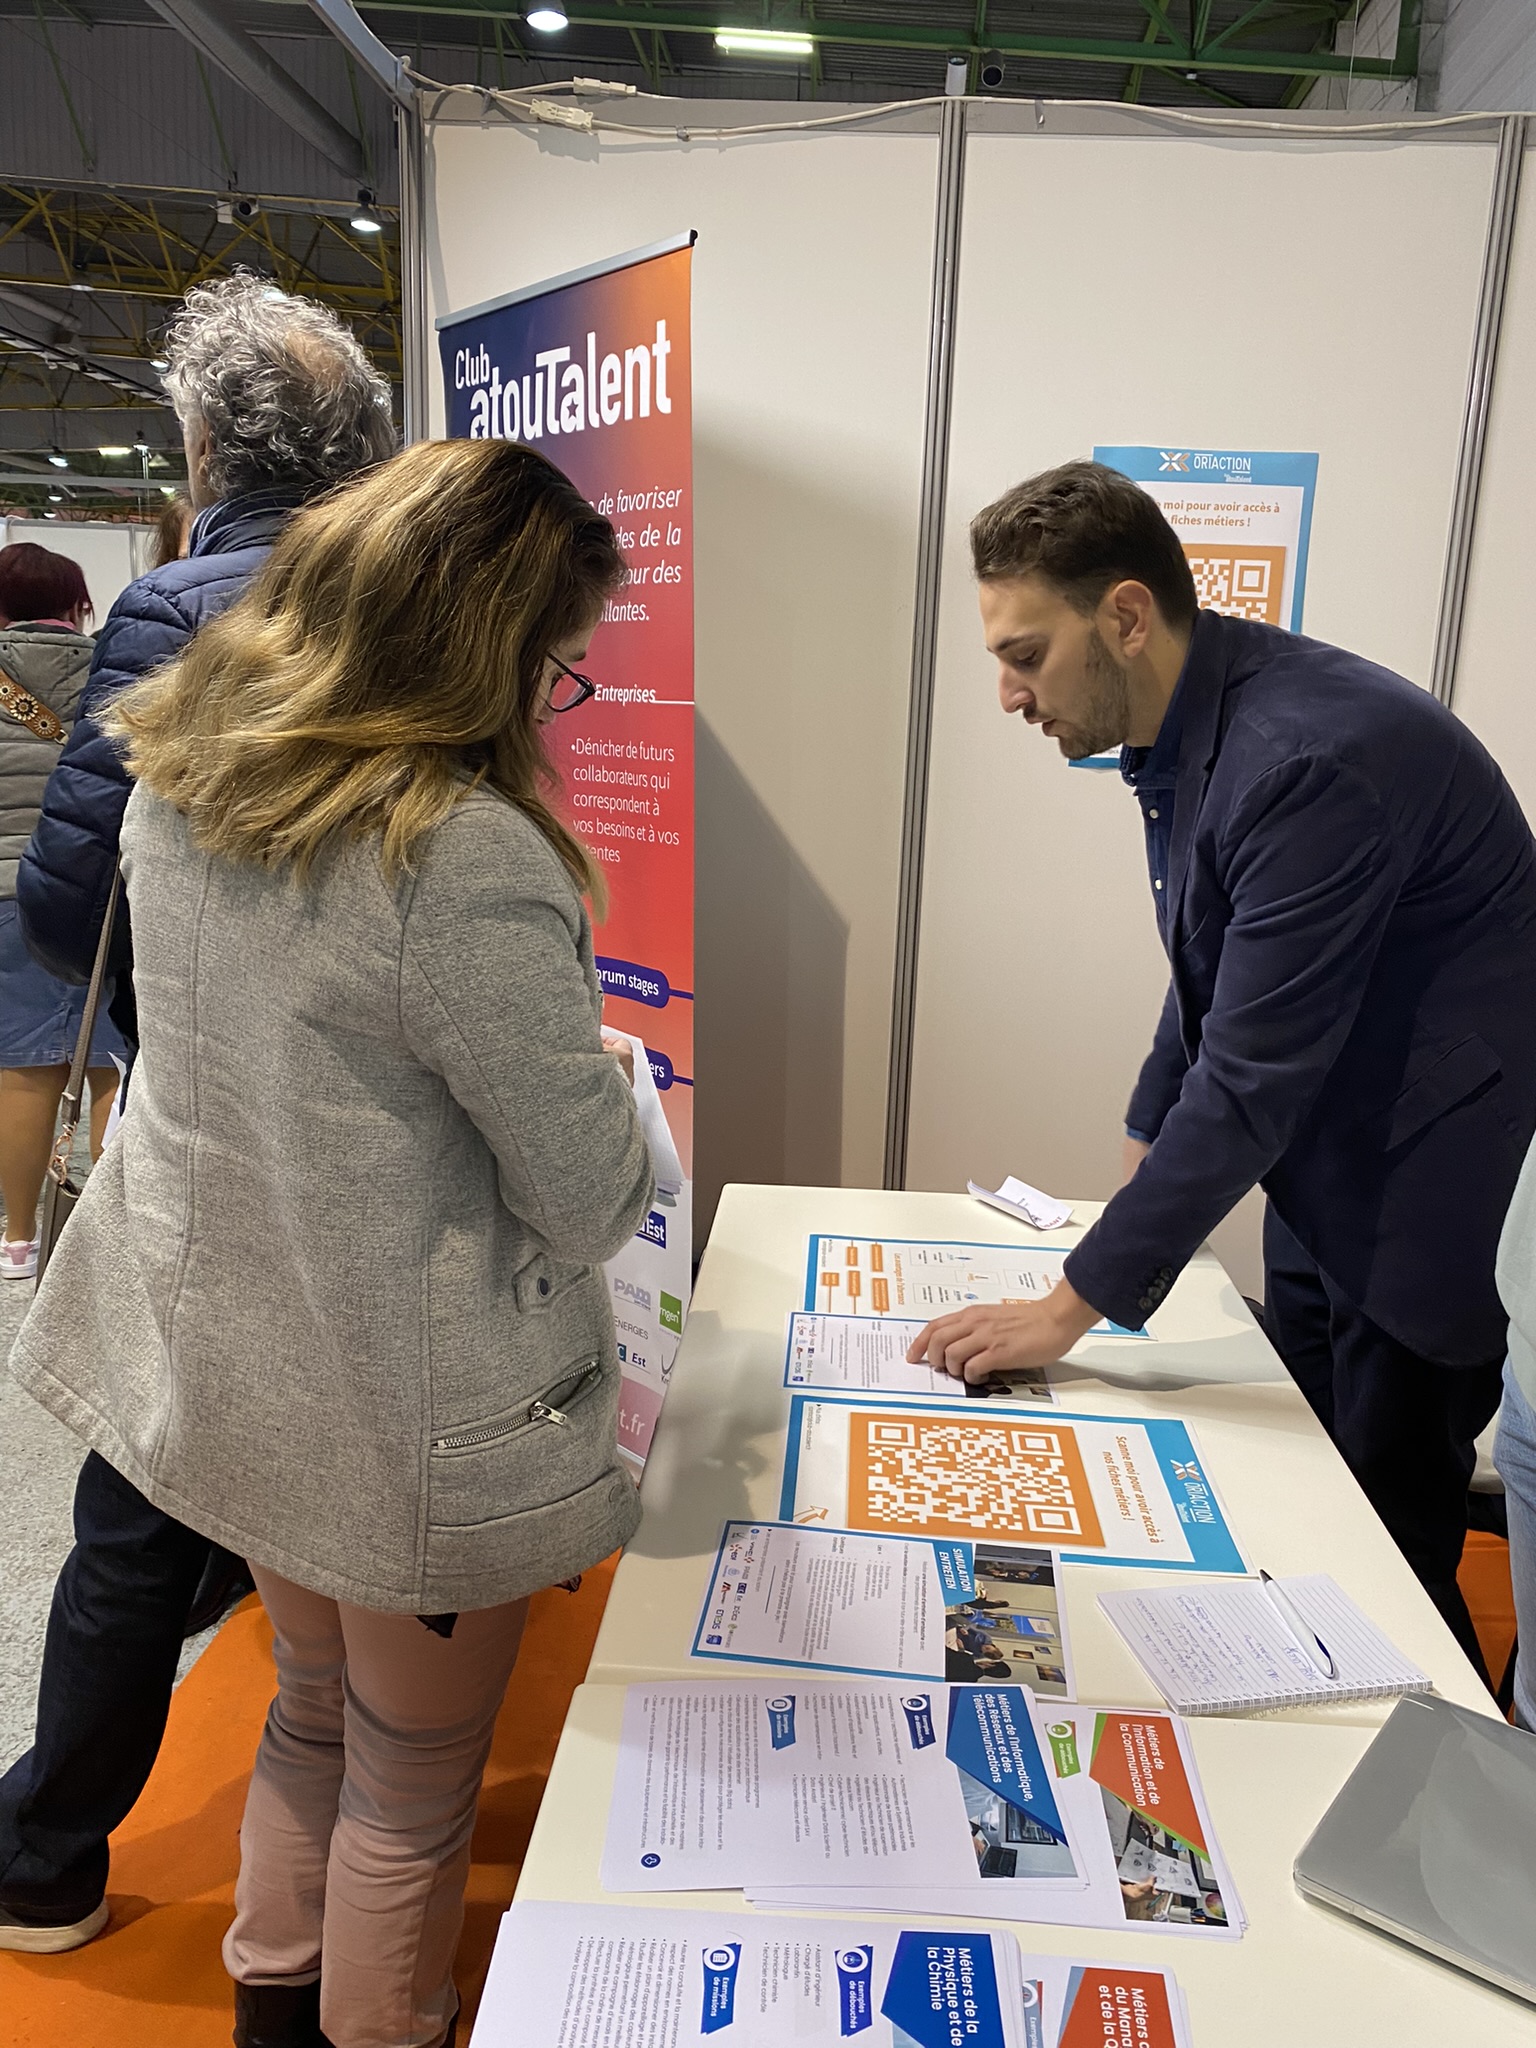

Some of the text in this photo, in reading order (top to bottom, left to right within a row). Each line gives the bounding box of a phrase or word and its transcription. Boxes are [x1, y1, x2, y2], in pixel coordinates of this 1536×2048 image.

[455, 343, 490, 390] Club
[1194, 455, 1251, 472] ORIACTION
[598, 485, 682, 515] de favoriser
[1164, 500, 1280, 513] moi pour avoir accès à
[1171, 515, 1201, 525] fiches
[1204, 515, 1245, 526] métiers
[640, 523, 660, 548] de
[666, 521, 681, 546] la
[652, 559, 682, 584] des
[602, 598, 650, 622] llantes.
[594, 683, 656, 706] Entreprises
[626, 743, 638, 759] de
[639, 741, 675, 762] futurs
[573, 765, 670, 793] collaborateurs qui
[573, 792, 660, 816] correspondent à
[573, 818, 680, 846] vos besoins et à vos
[596, 969, 659, 997] orum stages
[649, 1062, 665, 1078] ers
[660, 1307, 679, 1324] mgen
[632, 1352, 646, 1368] Est
[1102, 1452, 1115, 1464] nos
[1116, 1436, 1132, 1460] Scanne
[1106, 1465, 1122, 1486] fiches
[1124, 1461, 1140, 1475] moi
[1125, 1475, 1143, 1493] pour
[1113, 1487, 1131, 1517] métiers
[1135, 1494, 1152, 1514] avoir
[1183, 1482, 1216, 1524] ORIACTION
[1142, 1515, 1161, 1537] accès
[938, 1551, 956, 1590] ENTRETIEN
[952, 1548, 972, 1593] SIMULATION
[996, 1694, 1012, 1723] Métiers
[1006, 1725, 1016, 1735] de
[972, 1694, 1002, 1783] Télécommunications
[985, 1694, 1013, 1773] des Réseaux et des
[1145, 1725, 1165, 1769] Métiers de
[1119, 1723, 1146, 1807] la Communication
[1146, 1781, 1156, 1790] et
[1149, 1792, 1160, 1804] de
[849, 1980, 856, 1990] de
[927, 1947, 945, 2010] la Chimie
[958, 1948, 980, 2033] Métiers de la
[710, 1976, 720, 2016] de missions
[720, 1977, 729, 2009] Exemples
[857, 1981, 866, 2013] Exemples
[940, 1947, 965, 2046] Physique et de
[1098, 1985, 1112, 1998] et
[1100, 2001, 1114, 2018] de
[1115, 1986, 1133, 2048] du Mana
[1131, 1987, 1149, 2038] Métiers
[1103, 2021, 1117, 2035] la
